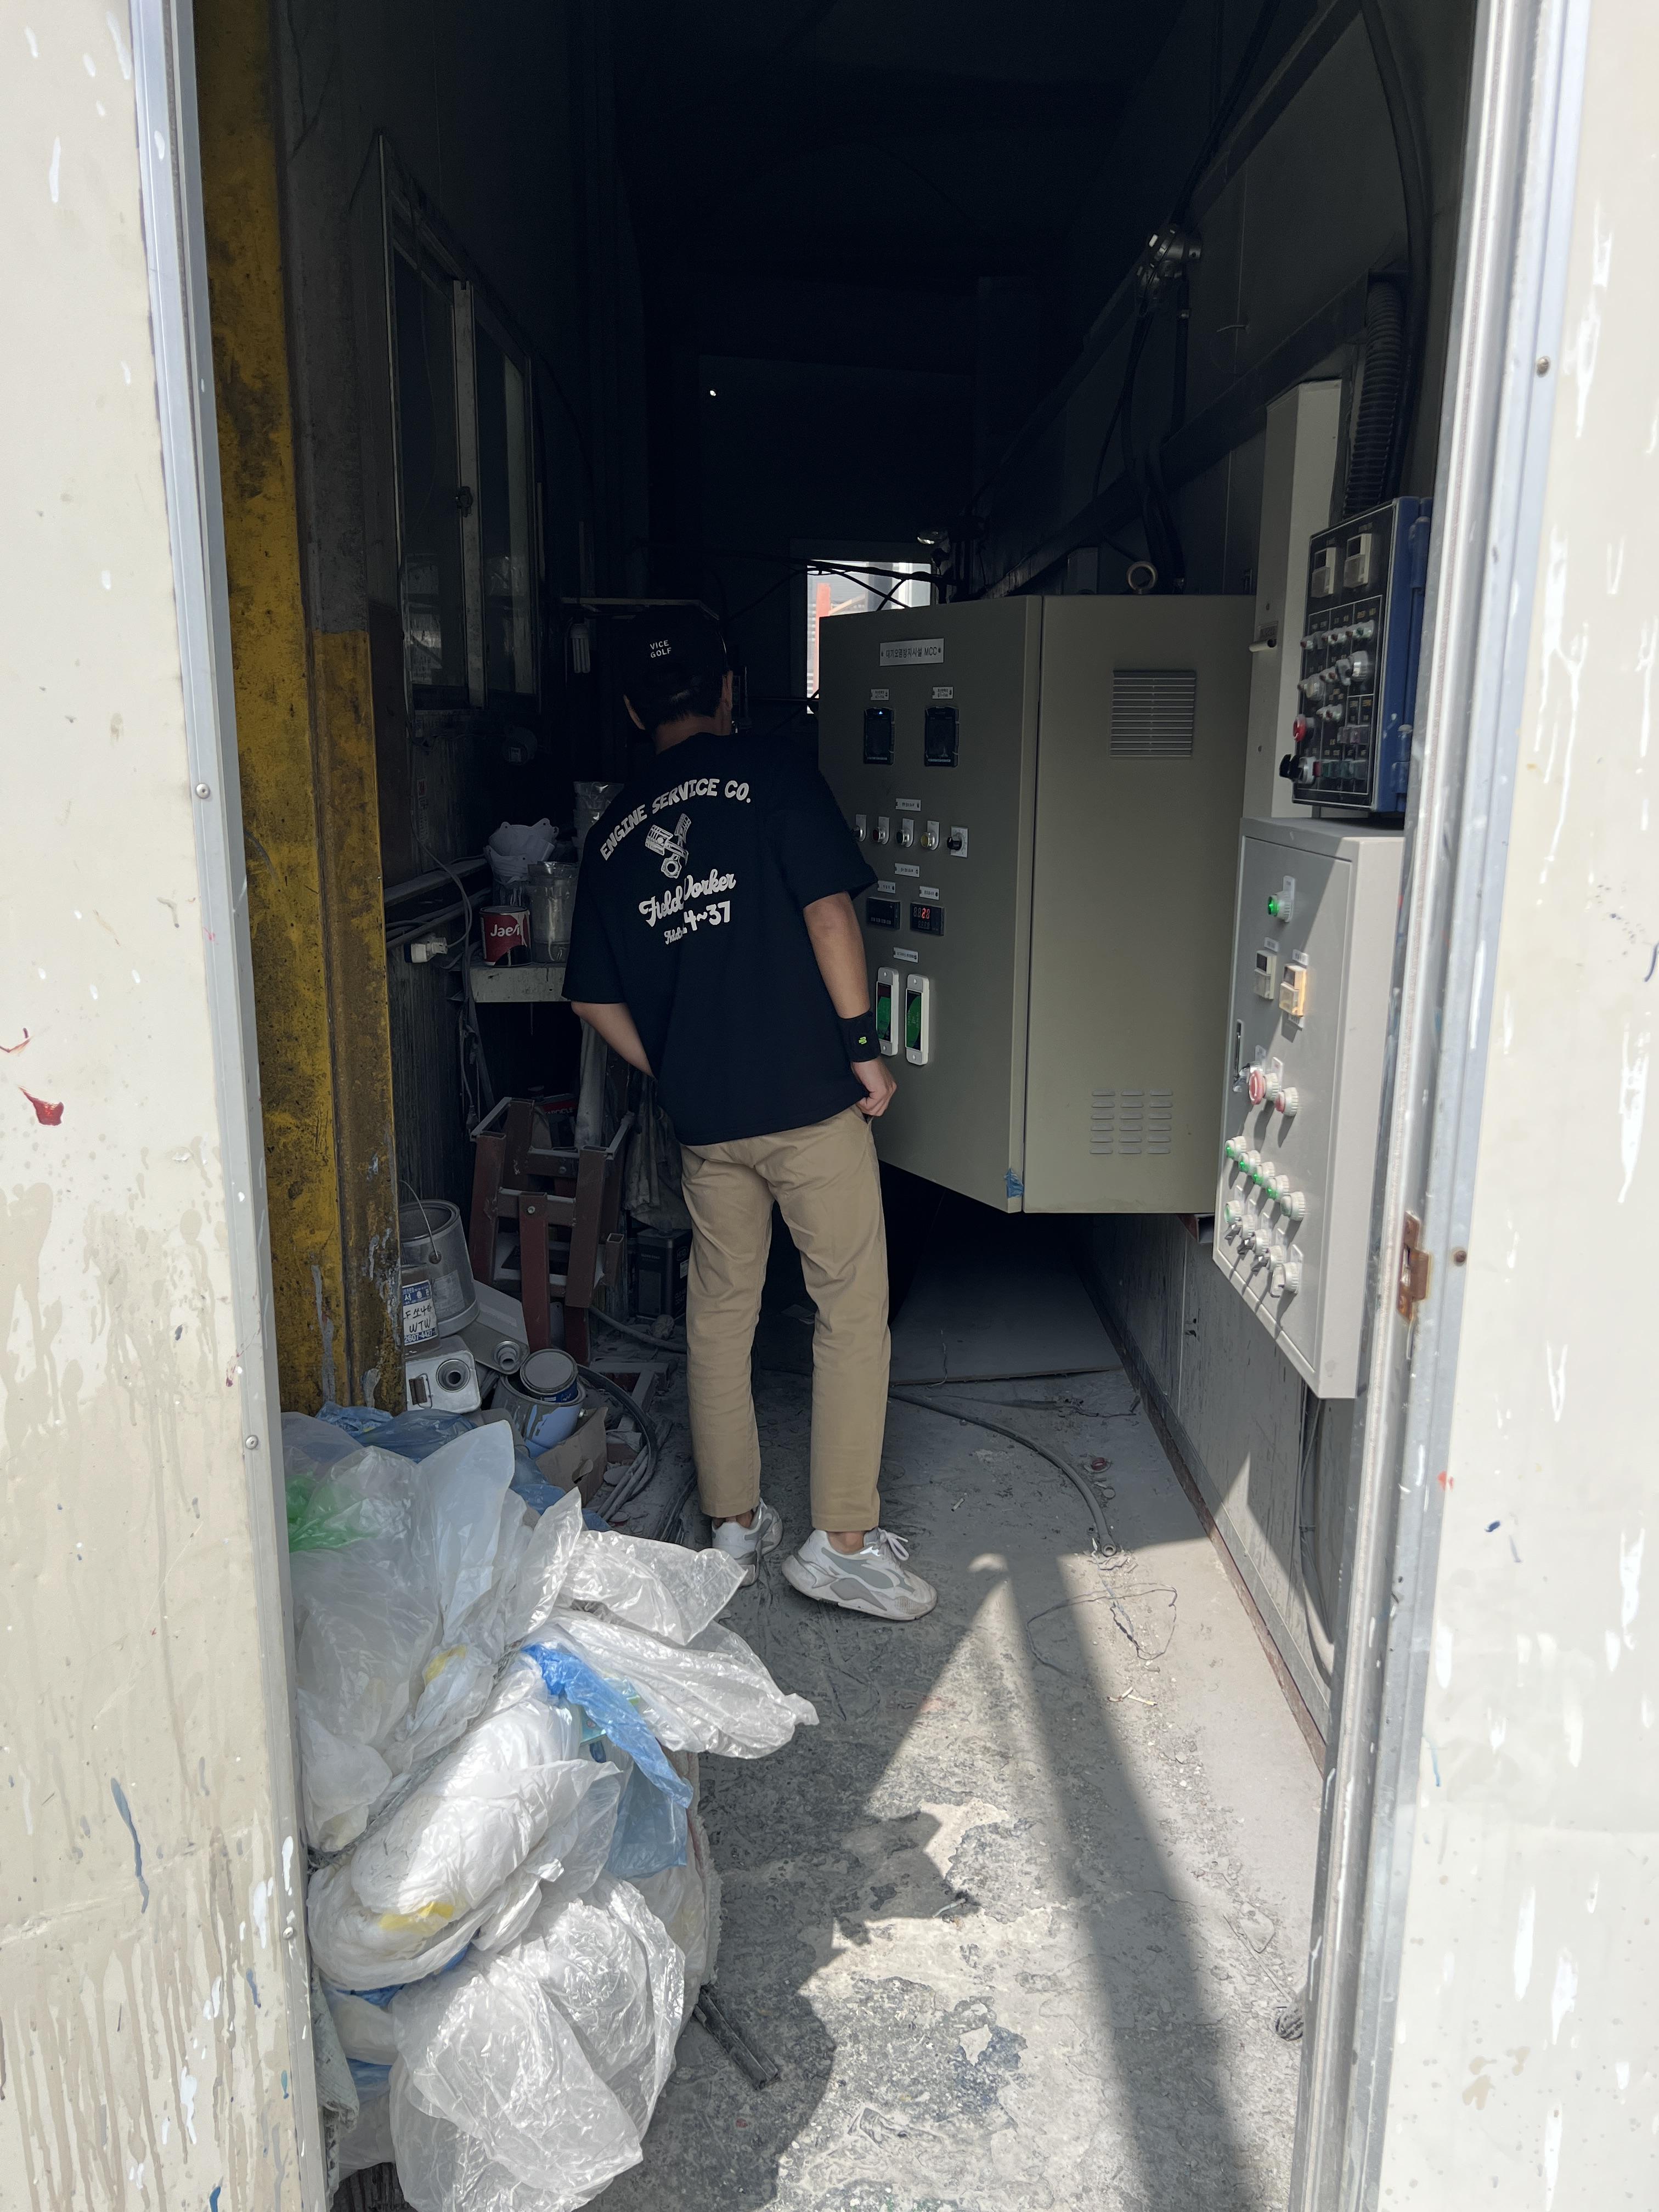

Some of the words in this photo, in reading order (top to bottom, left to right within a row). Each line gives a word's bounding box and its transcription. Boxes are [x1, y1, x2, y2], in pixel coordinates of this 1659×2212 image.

[650, 640, 670, 650] VICE
[650, 647, 672, 658] GOLF
[924, 646, 937, 656] MCC
[600, 804, 647, 861] ENGINE
[652, 778, 720, 814] SERVICE
[725, 780, 751, 804] CO.
[409, 1315, 431, 1333] WTW
